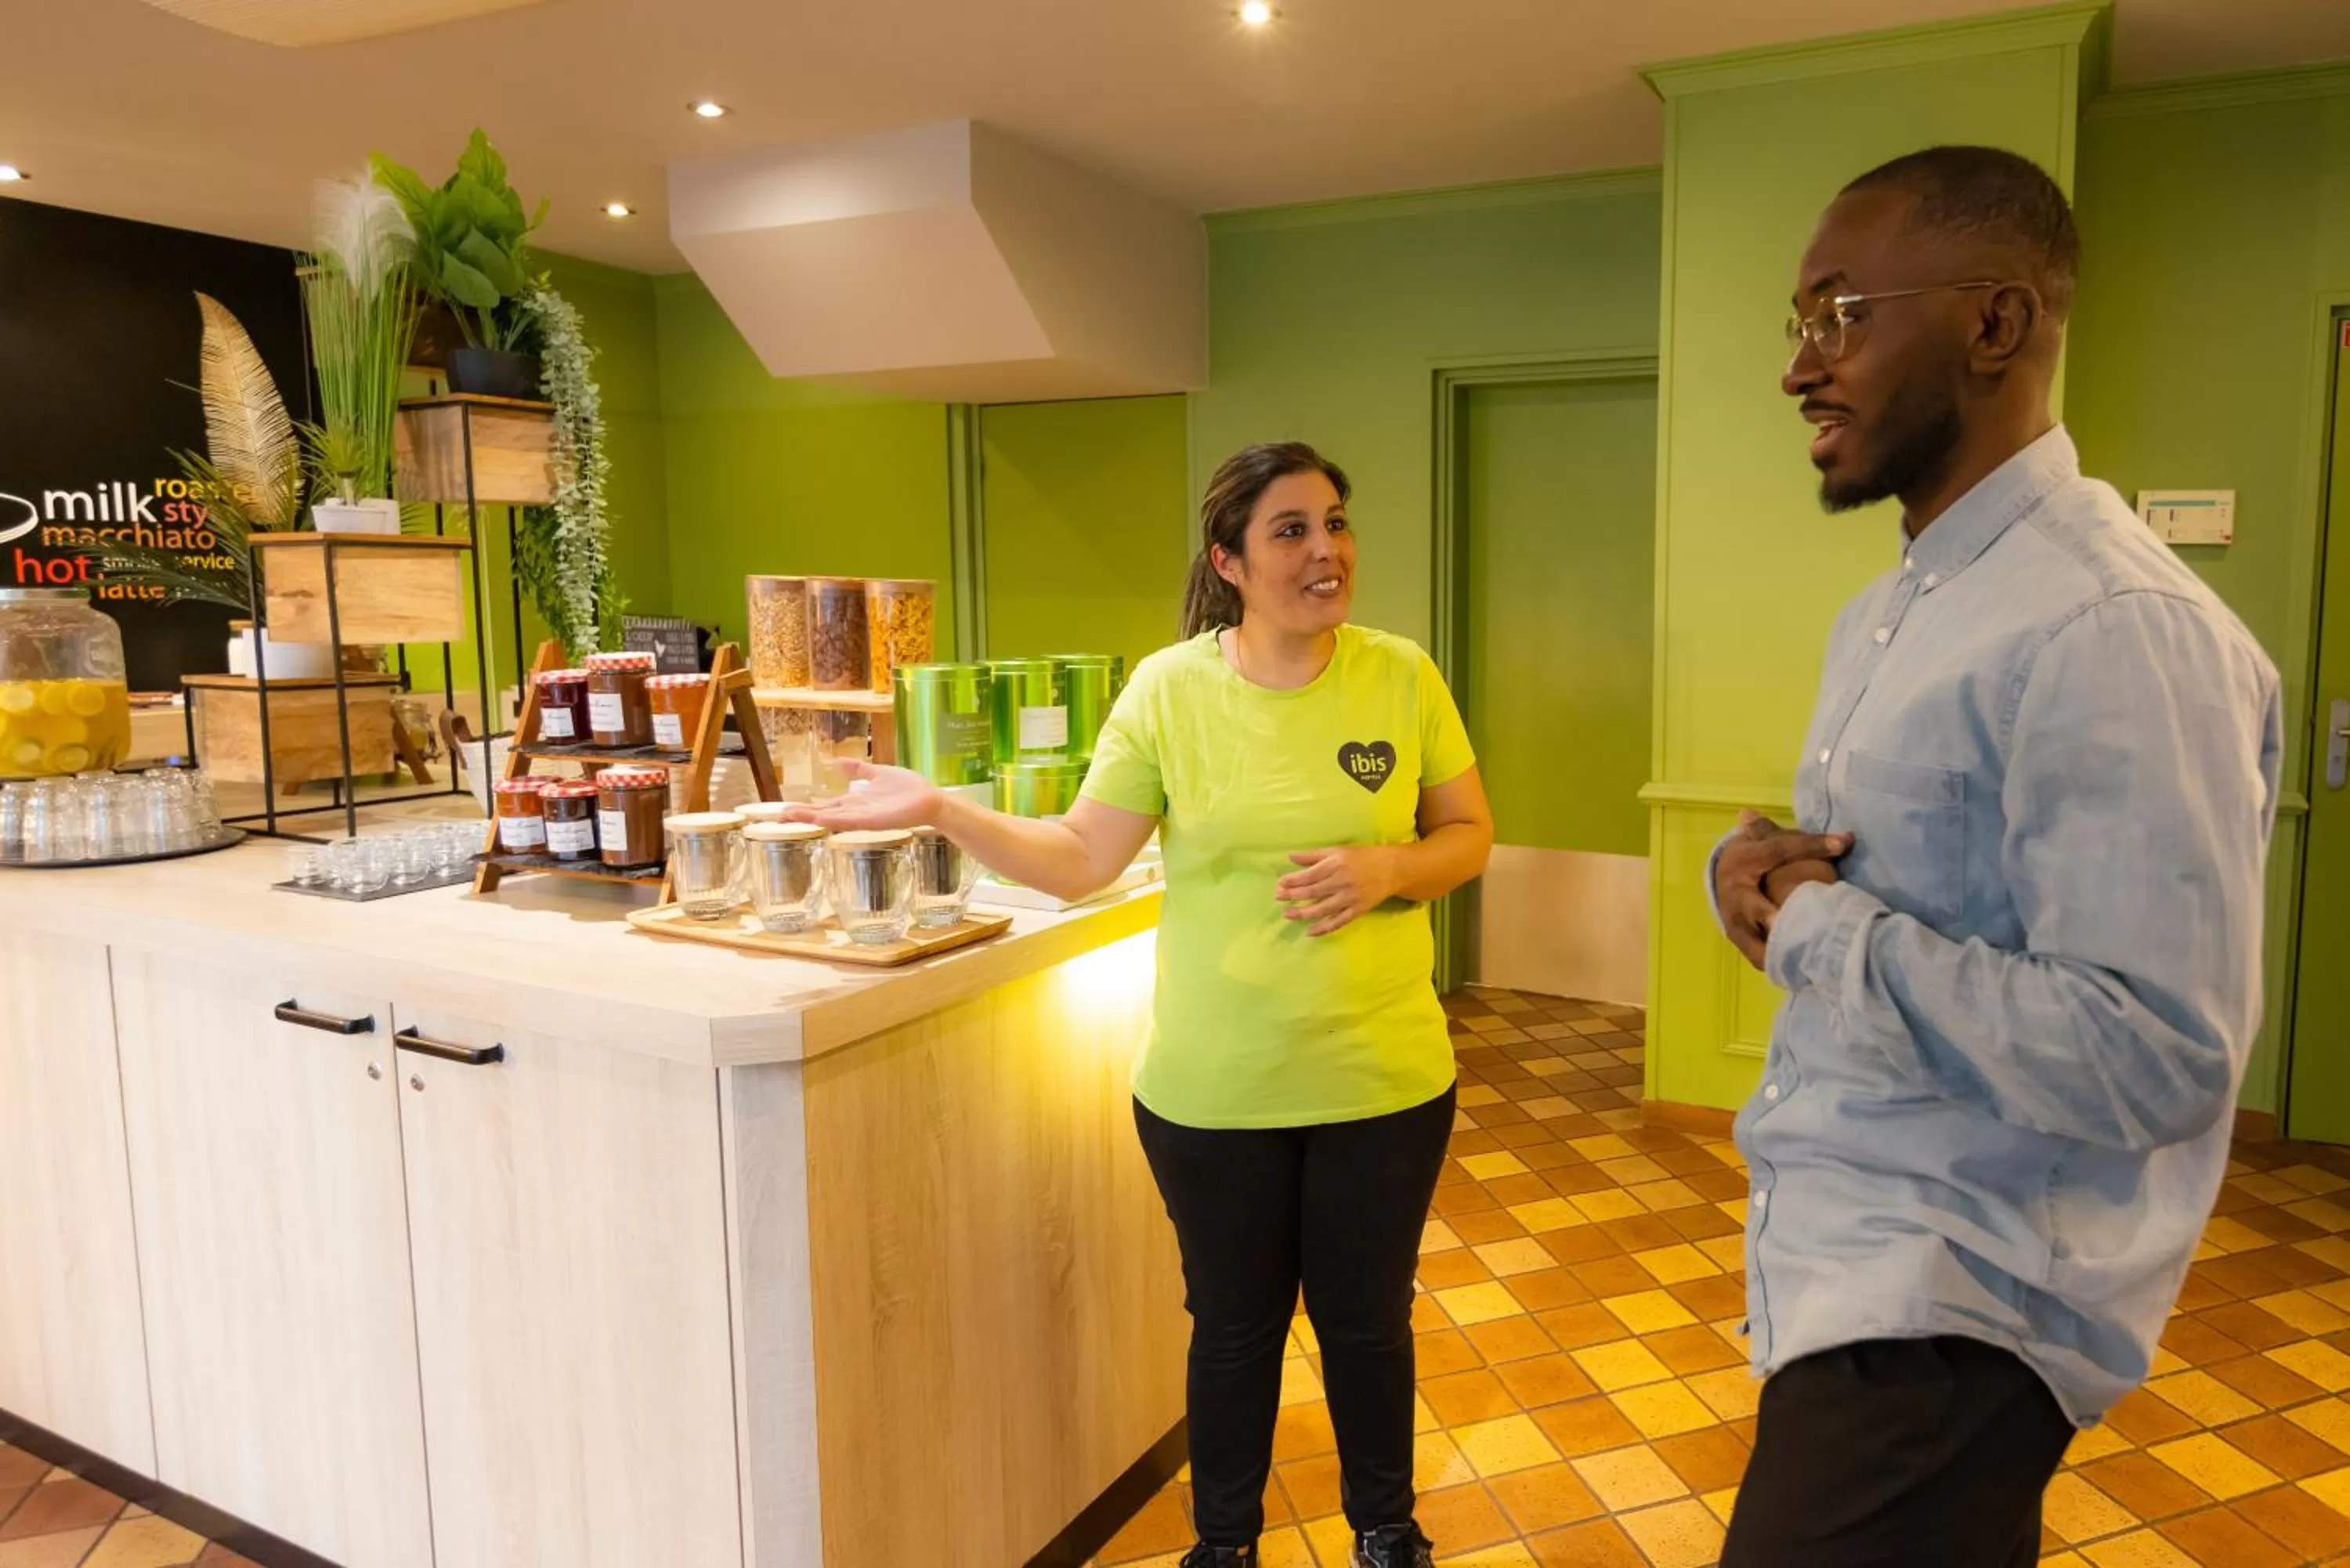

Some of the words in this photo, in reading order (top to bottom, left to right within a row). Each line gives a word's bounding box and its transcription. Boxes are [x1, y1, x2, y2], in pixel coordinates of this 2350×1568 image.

[44, 481, 158, 522] milk
[163, 500, 208, 529] sty
[42, 521, 215, 549] macchiato
[13, 548, 92, 583] hot
[175, 552, 236, 570] ervice
[1350, 753, 1386, 774] ibis
